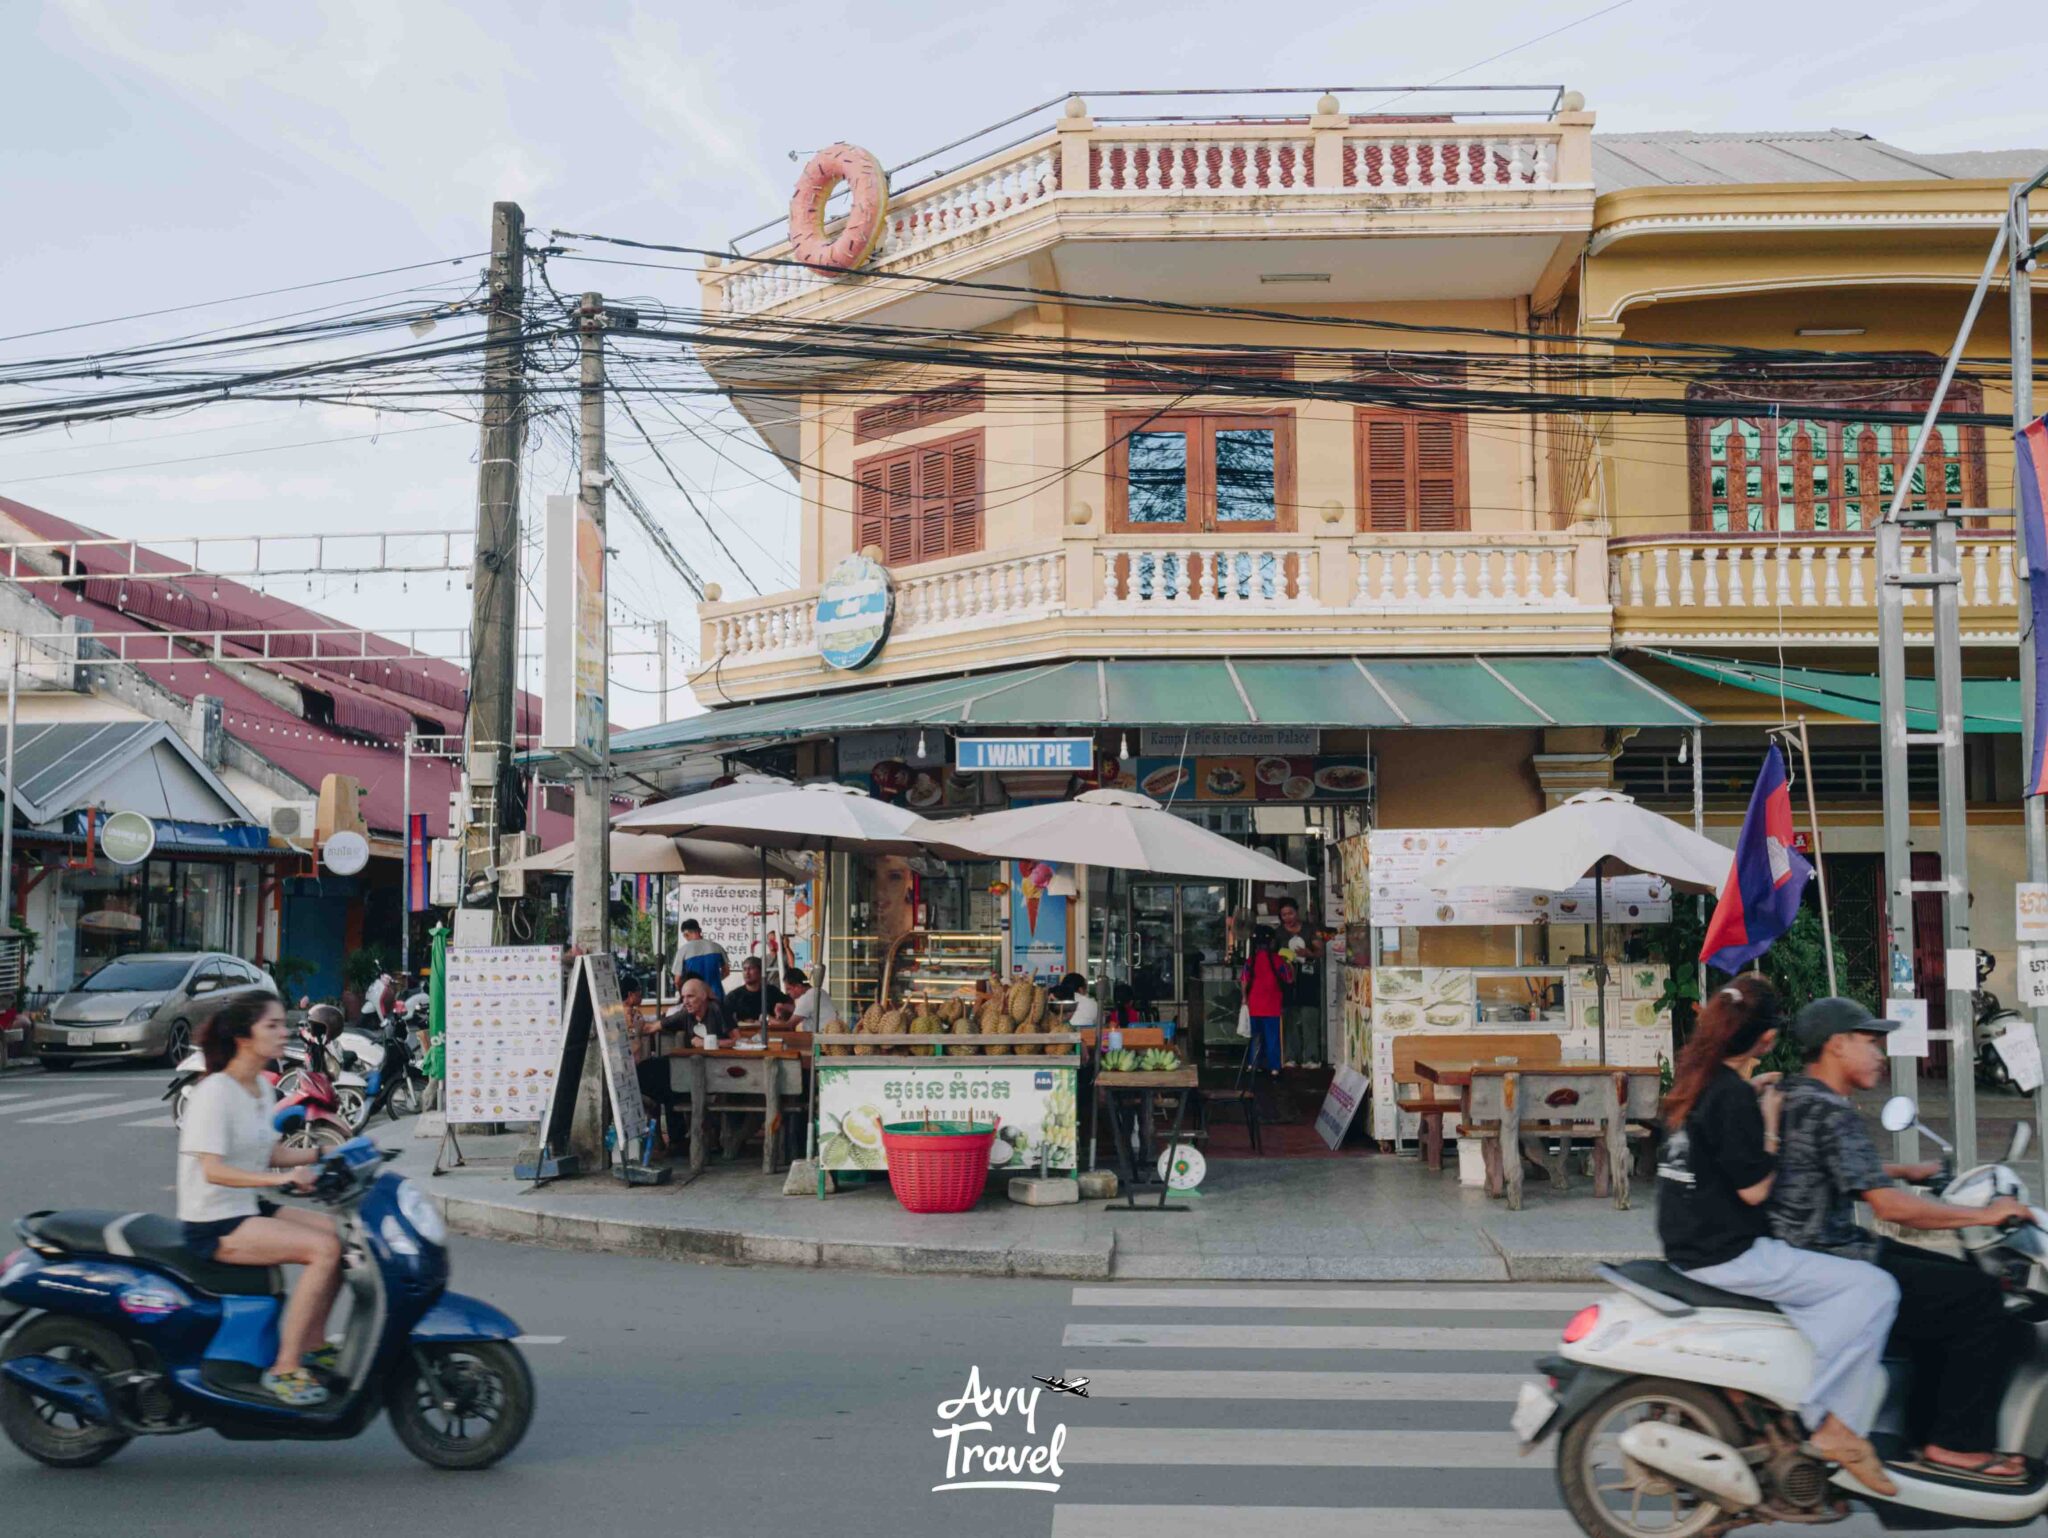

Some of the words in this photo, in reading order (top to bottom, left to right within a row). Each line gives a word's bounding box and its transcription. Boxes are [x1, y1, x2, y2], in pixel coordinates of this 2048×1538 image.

[1194, 731, 1213, 745] Pie
[1213, 732, 1221, 745] &
[1223, 731, 1239, 745] Ice
[1240, 731, 1274, 745] Cream
[1277, 730, 1311, 745] Palace
[977, 744, 985, 766] I
[987, 744, 1041, 766] WANT
[1044, 744, 1073, 766] PIE
[682, 904, 699, 913] We
[702, 904, 729, 913] Have
[702, 932, 725, 941] FOR
[728, 932, 760, 941] RENT
[952, 1109, 994, 1120] DUIAN
